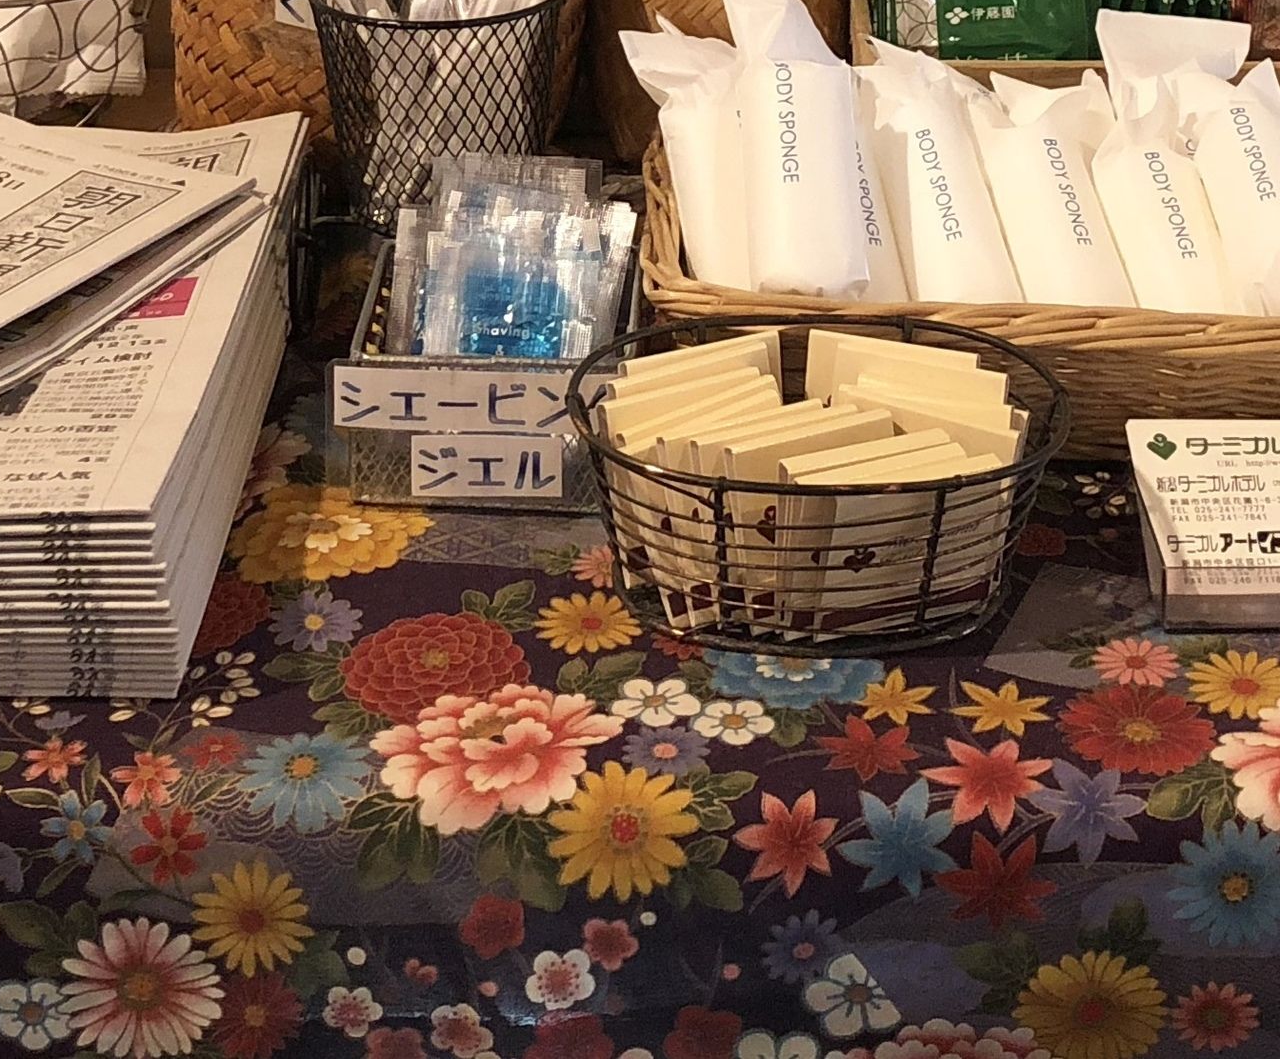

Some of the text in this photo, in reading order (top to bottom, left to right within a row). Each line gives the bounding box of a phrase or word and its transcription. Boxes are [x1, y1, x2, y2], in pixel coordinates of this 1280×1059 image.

[970, 5, 1016, 22] 伊藤園
[778, 111, 800, 183] SPONGE
[915, 128, 963, 242] BODY SPONGE
[1229, 107, 1277, 201] BODY SPONGE
[1043, 138, 1092, 246] BODY SPONGE
[1143, 151, 1198, 260] BODY SPONGE
[418, 447, 557, 490] ジェル
[1172, 514, 1190, 522] FAX
